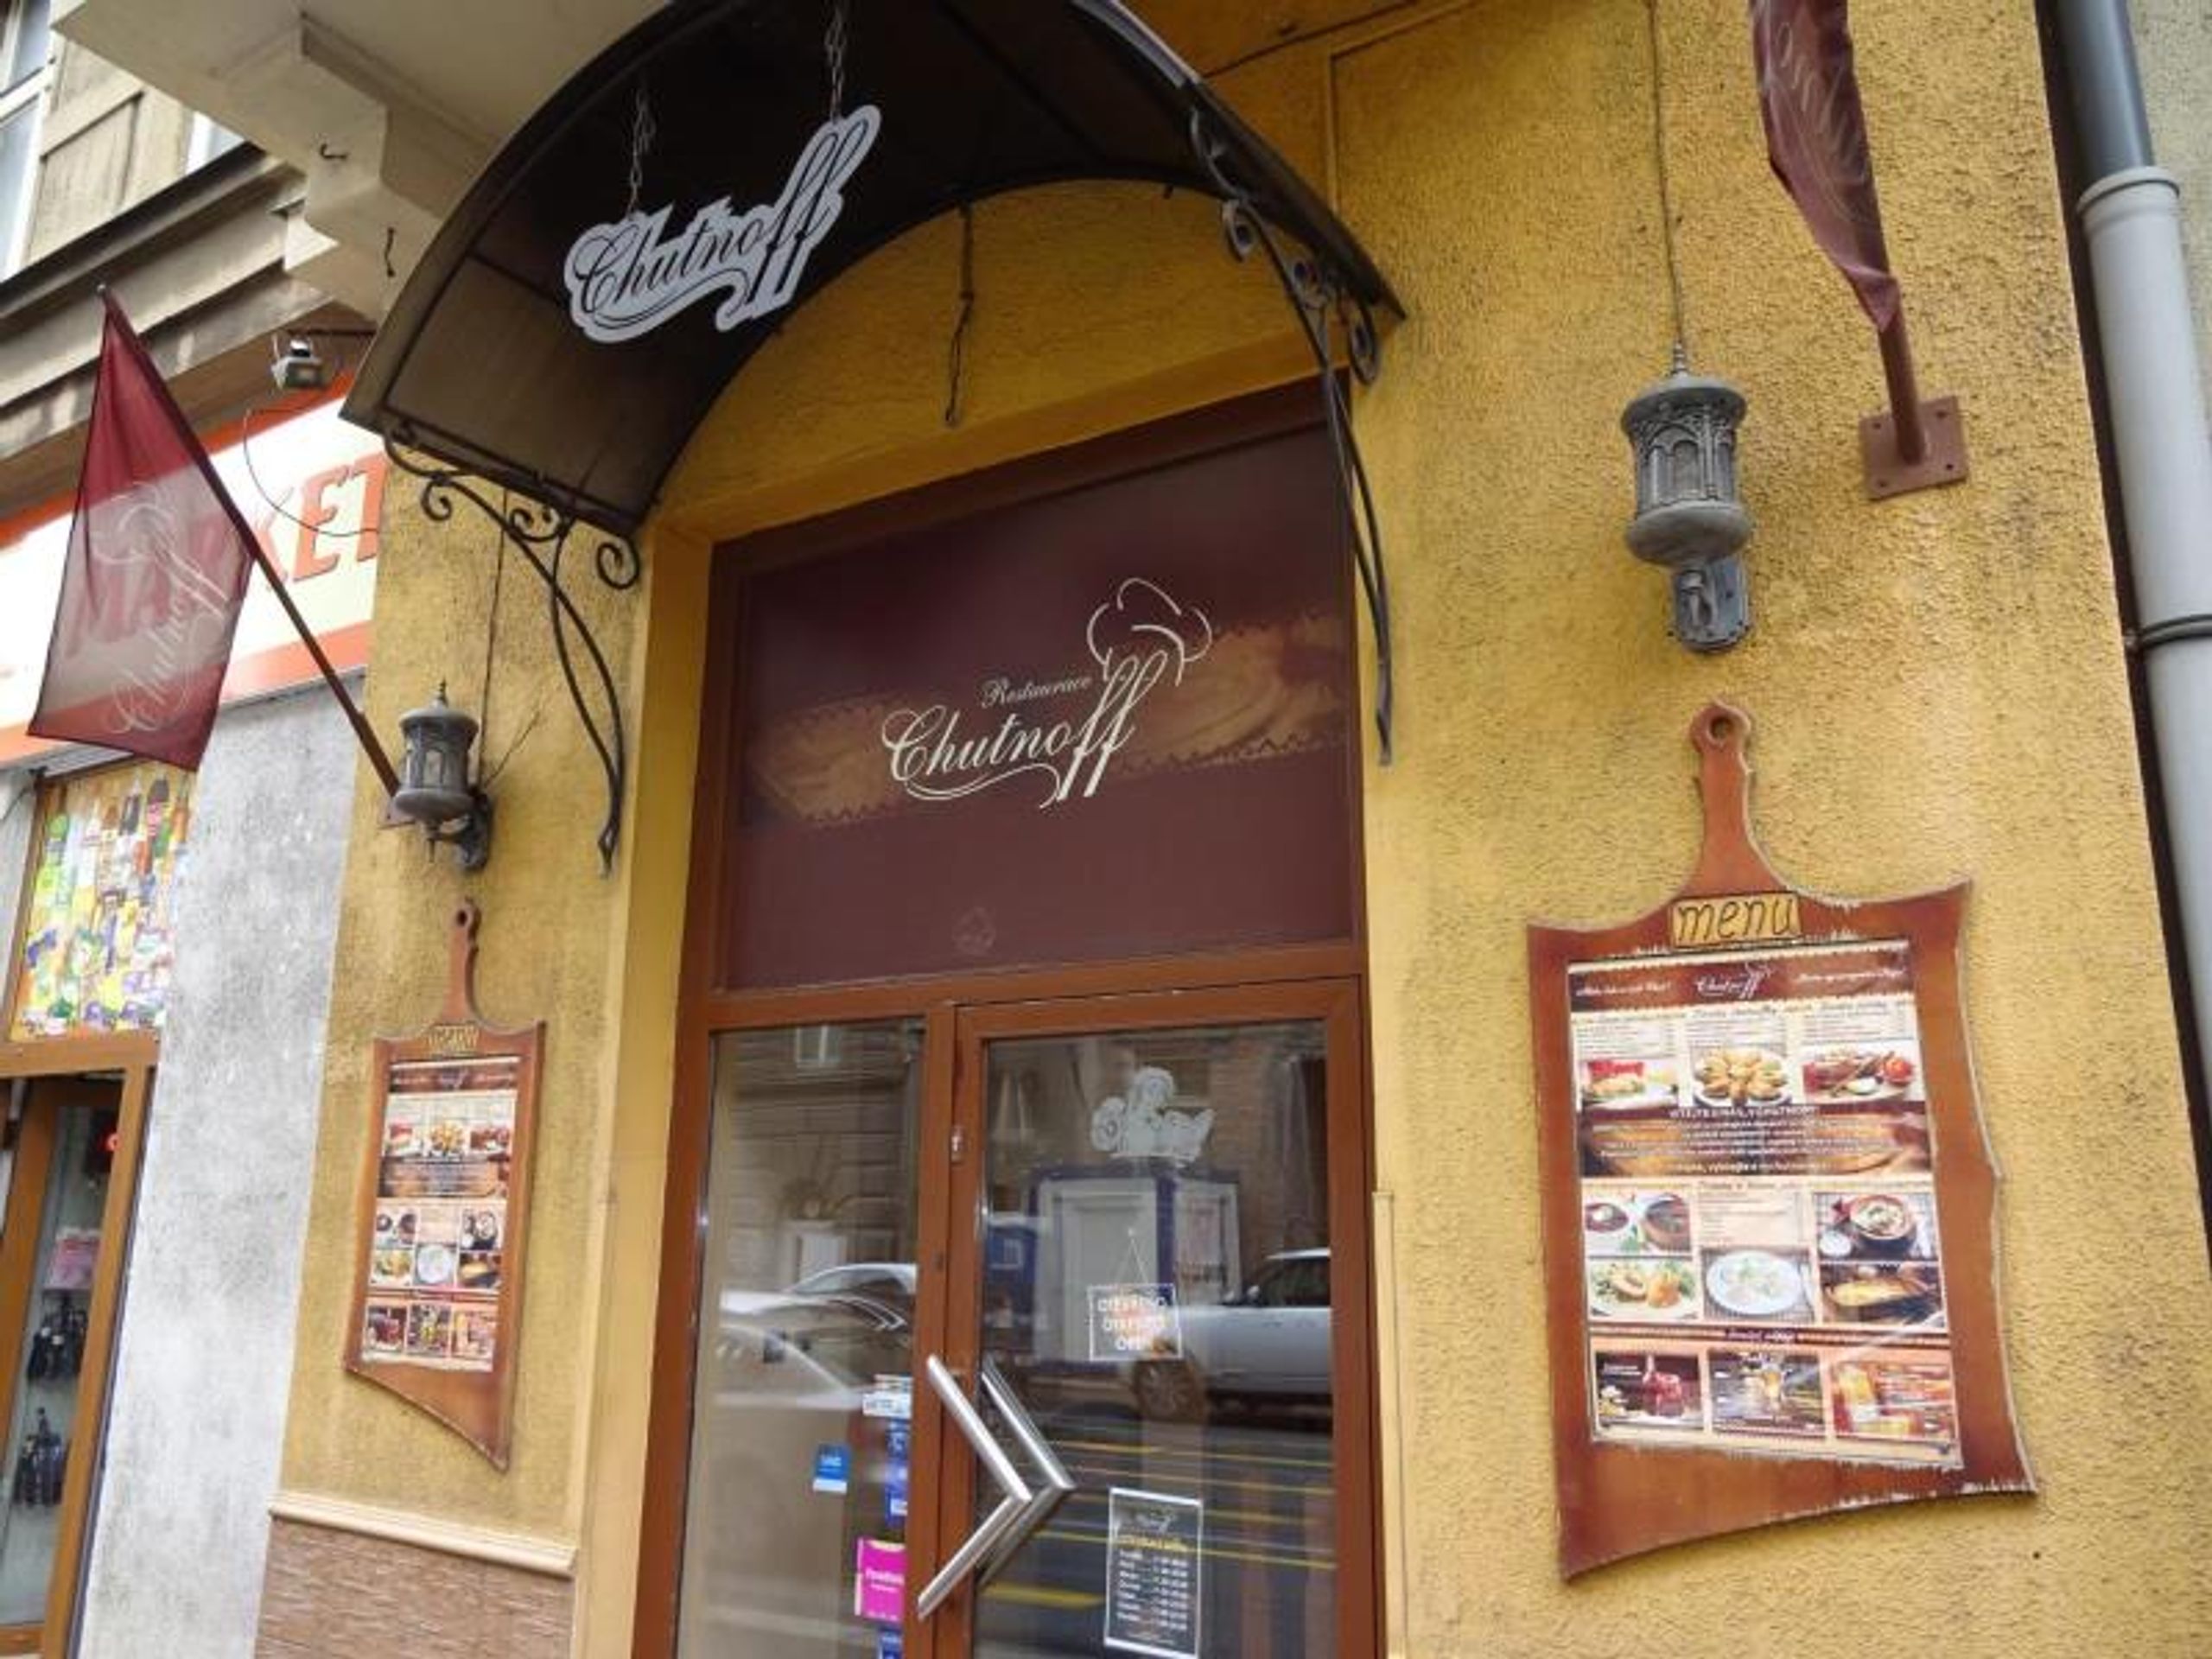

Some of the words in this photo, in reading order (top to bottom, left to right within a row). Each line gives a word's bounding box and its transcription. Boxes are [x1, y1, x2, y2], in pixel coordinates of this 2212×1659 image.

[572, 119, 868, 329] Chutnoff
[881, 650, 1168, 808] Chutnoff
[1678, 899, 1793, 941] menu
